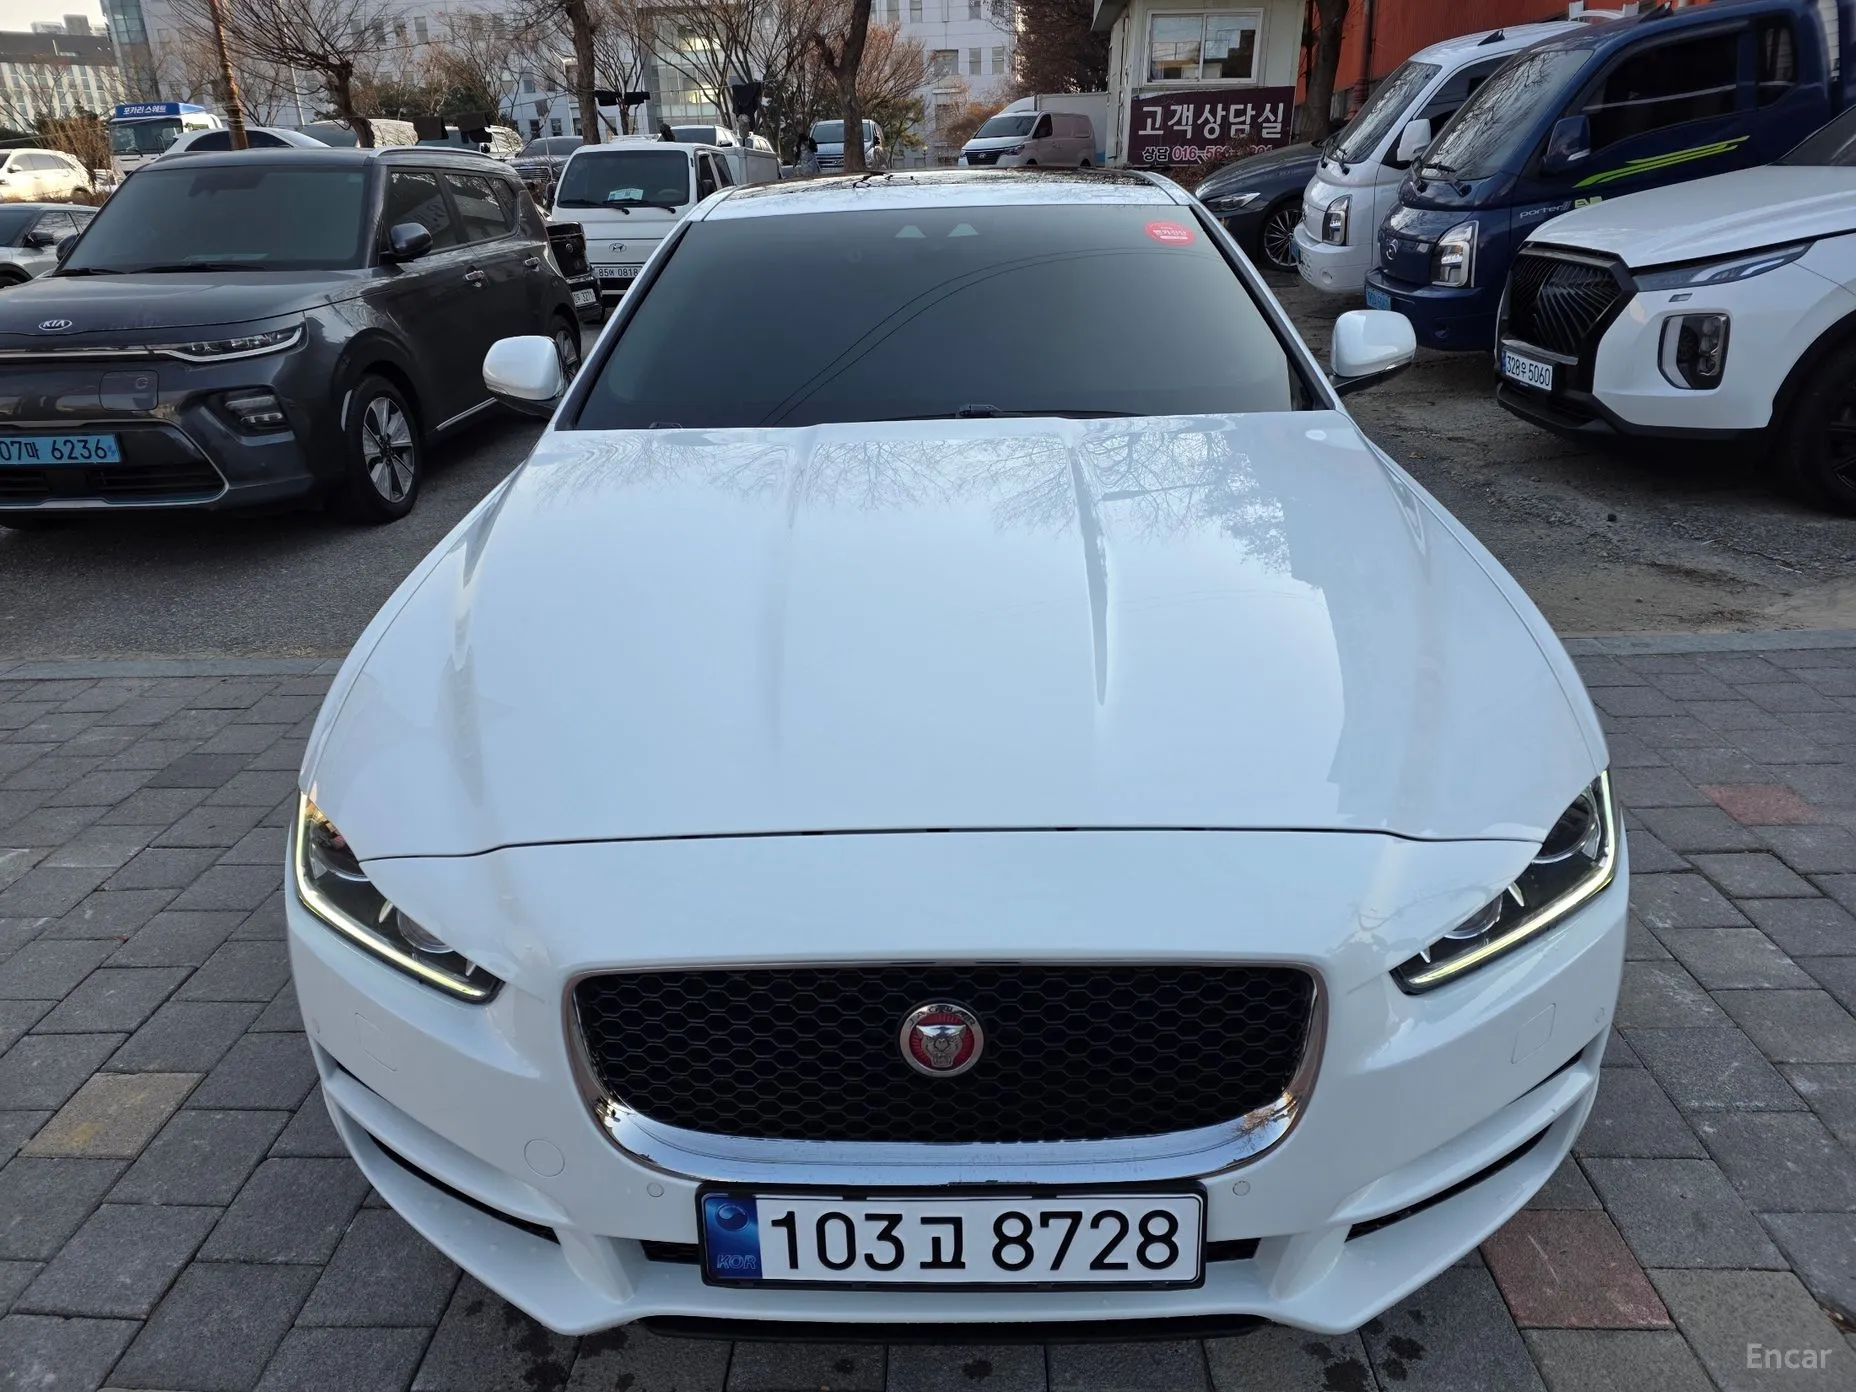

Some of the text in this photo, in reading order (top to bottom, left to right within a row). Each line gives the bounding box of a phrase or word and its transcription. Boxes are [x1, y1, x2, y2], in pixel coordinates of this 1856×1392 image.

[123, 106, 144, 115] 포카리
[1138, 102, 1284, 139] 고객상담실
[1142, 146, 1169, 162] 상담
[617, 268, 638, 277] 0818
[42, 319, 66, 328] KIA
[1506, 355, 1550, 386] 328우 5060
[51, 439, 107, 460] 6236
[907, 1005, 976, 1026] JAGUAR
[771, 1209, 1179, 1271] 103고 8728
[717, 1254, 756, 1269] KOR
